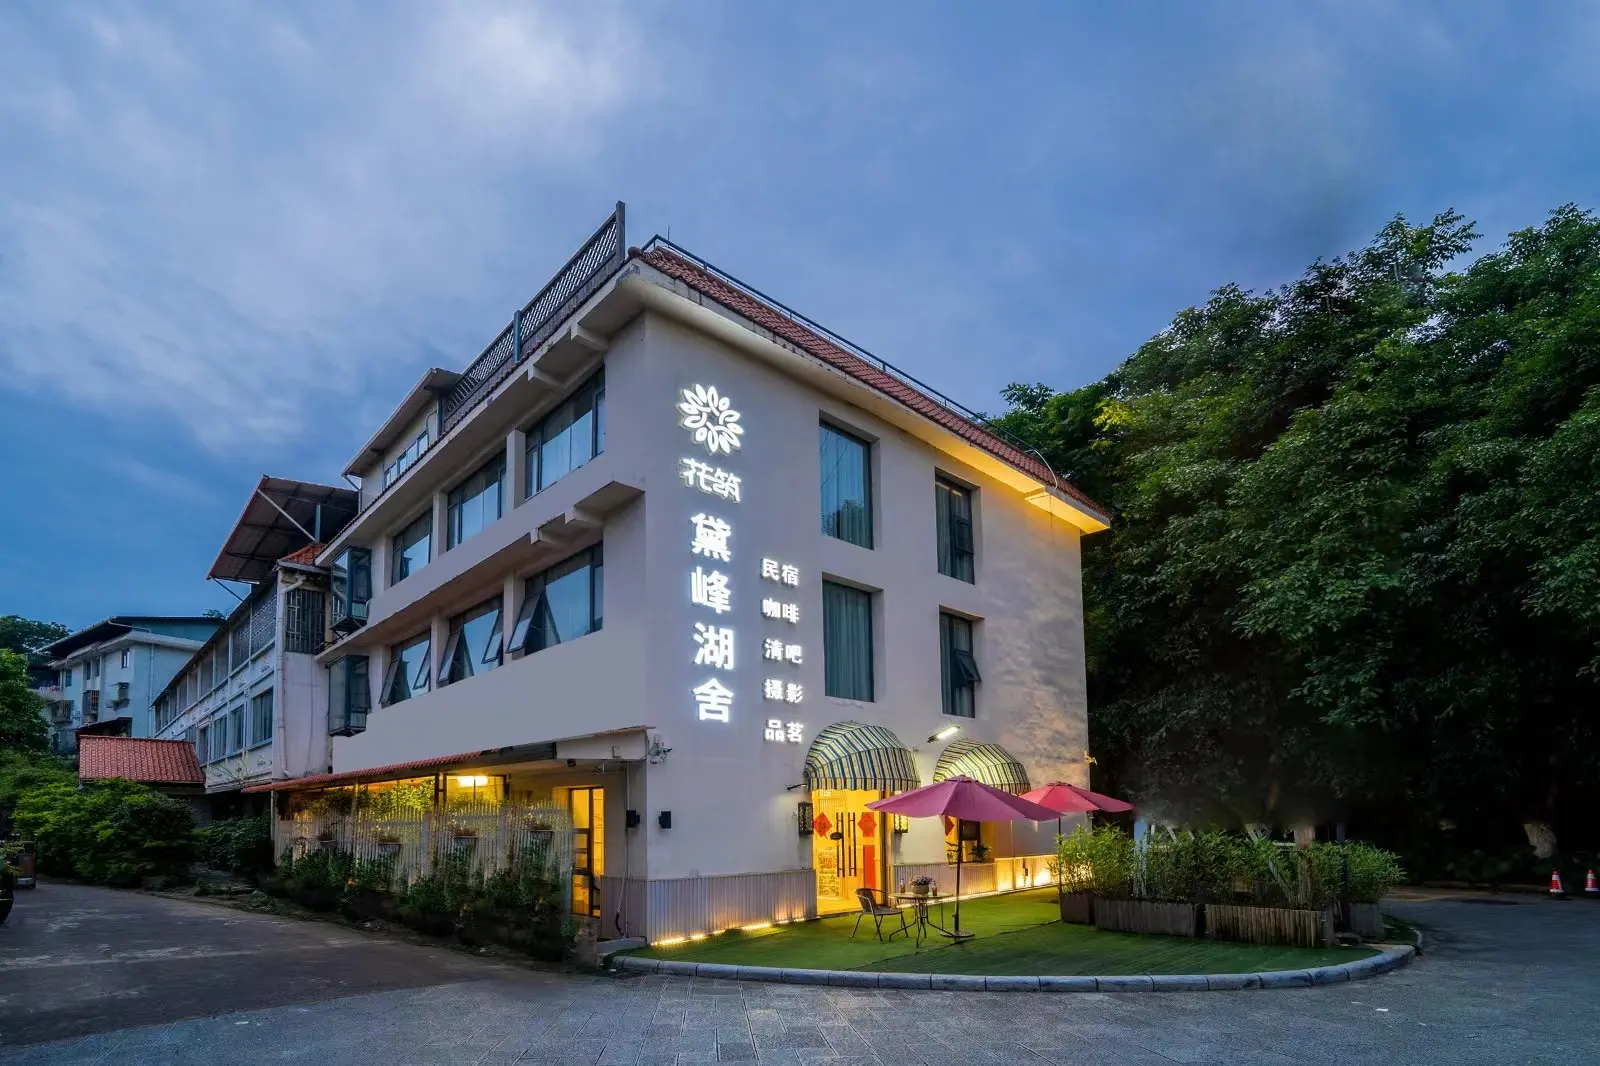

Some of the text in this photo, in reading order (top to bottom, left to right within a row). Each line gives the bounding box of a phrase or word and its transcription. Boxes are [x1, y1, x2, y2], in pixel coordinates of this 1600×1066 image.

[681, 458, 742, 502] 花筑
[762, 557, 799, 586] 民宿
[690, 512, 735, 724] 黛峰湖舍
[762, 597, 800, 624] 咖啡
[764, 638, 803, 665] 清吧
[764, 678, 804, 704] 摄影
[764, 719, 804, 743] 品茗
